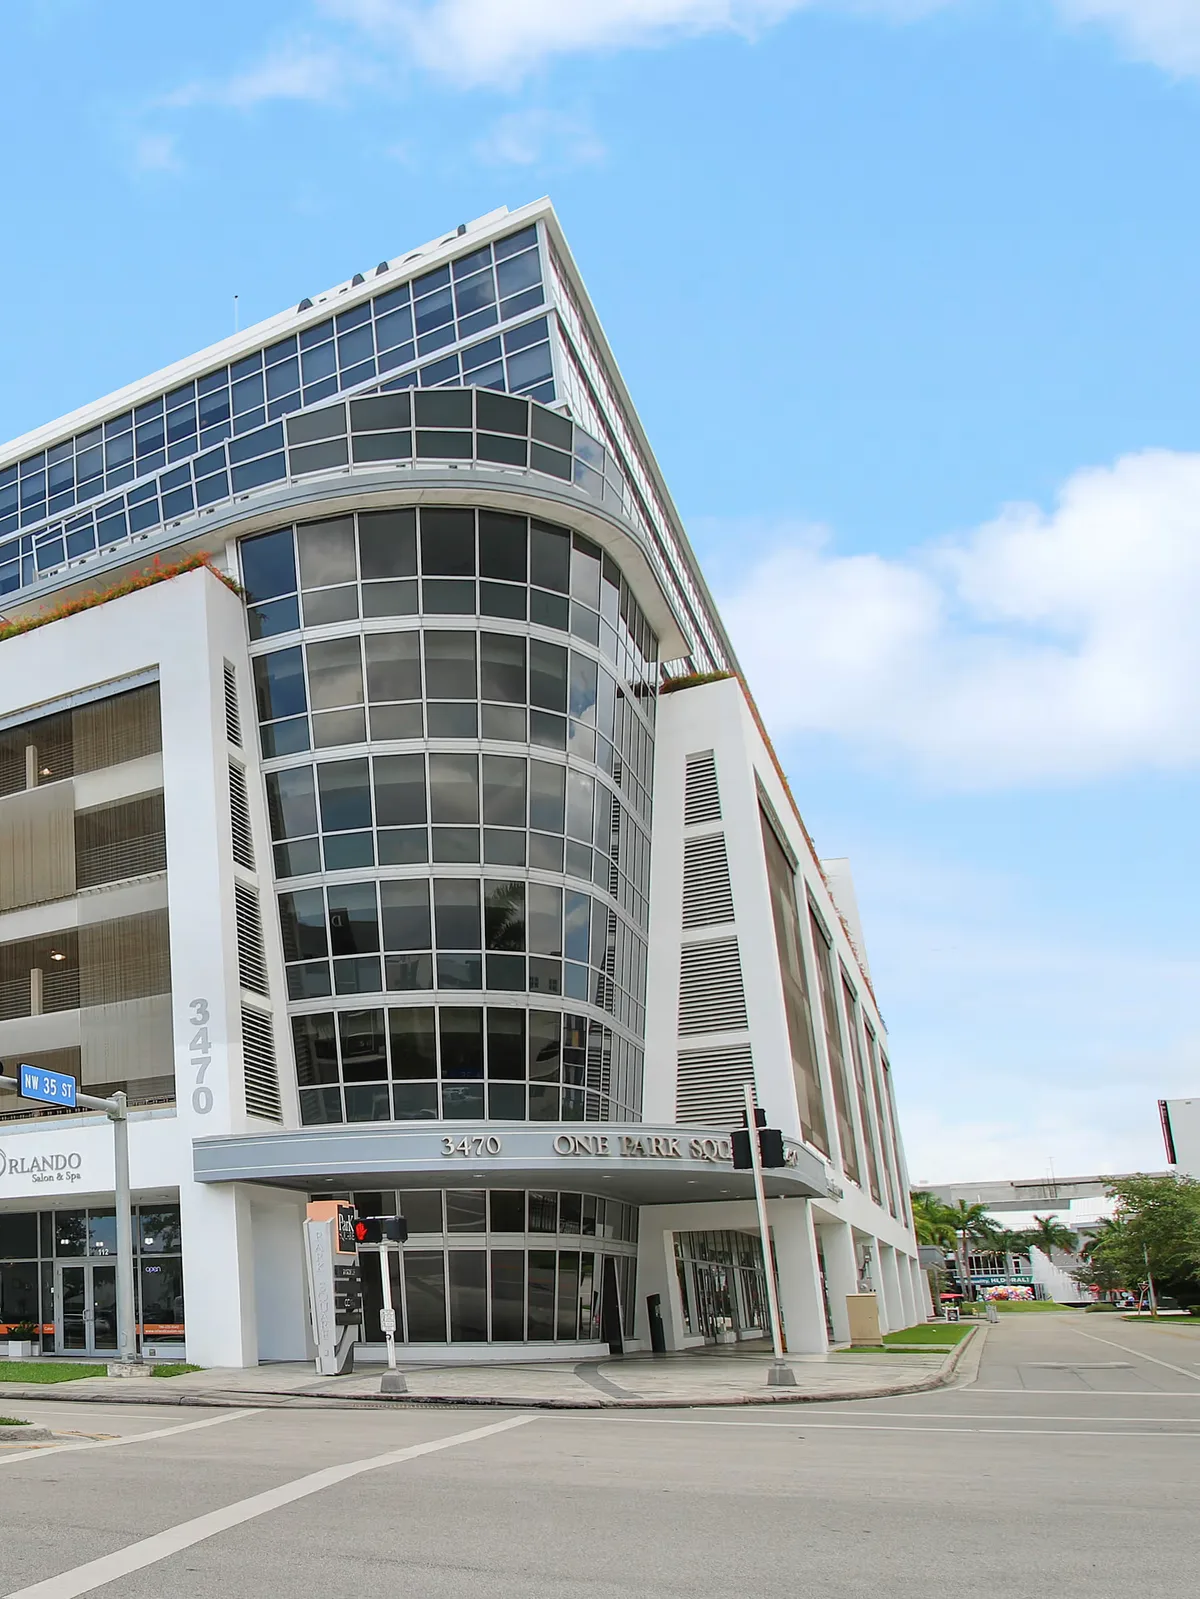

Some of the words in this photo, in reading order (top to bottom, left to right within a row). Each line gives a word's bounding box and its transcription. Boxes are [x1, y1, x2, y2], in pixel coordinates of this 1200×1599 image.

[189, 998, 213, 1114] 3470
[25, 1073, 39, 1090] NW
[43, 1077, 57, 1096] 35
[61, 1083, 72, 1098] ST
[441, 1136, 501, 1156] 3470
[553, 1135, 610, 1156] ONE
[618, 1136, 682, 1158] PARK
[32, 1173, 54, 1183] Salon
[56, 1172, 63, 1181] &
[65, 1171, 81, 1183] Spa
[98, 1248, 109, 1256] 112
